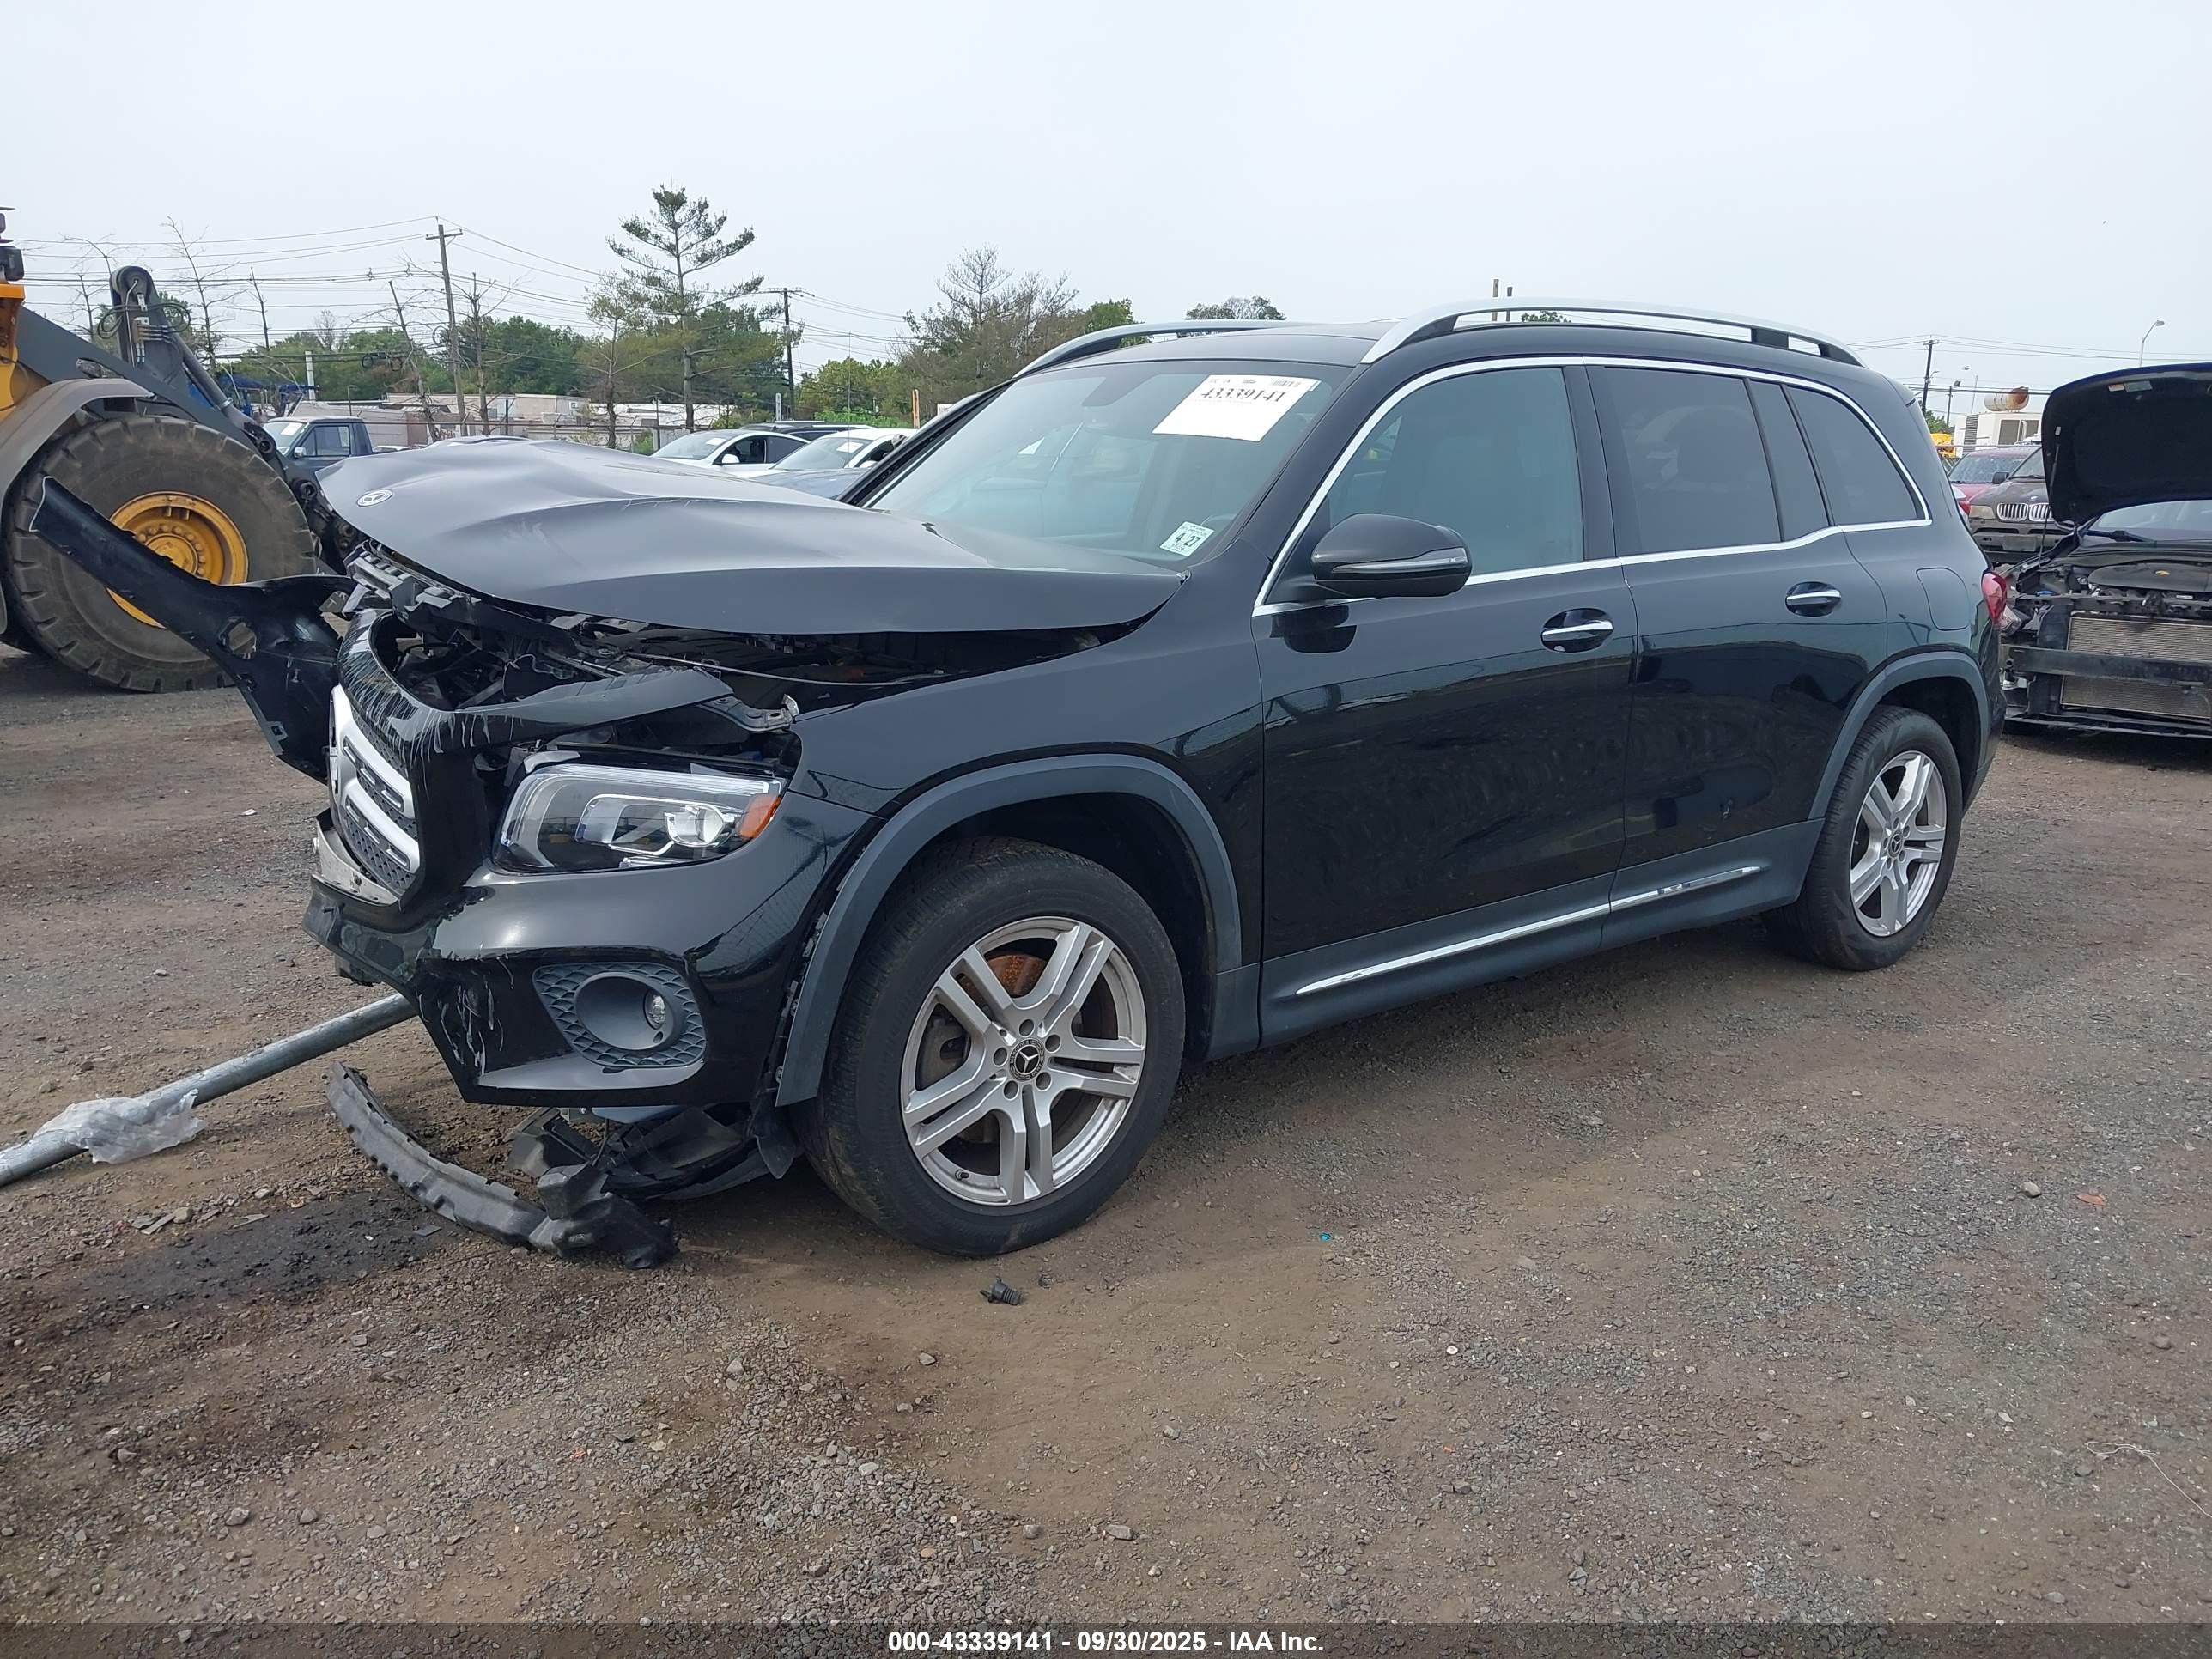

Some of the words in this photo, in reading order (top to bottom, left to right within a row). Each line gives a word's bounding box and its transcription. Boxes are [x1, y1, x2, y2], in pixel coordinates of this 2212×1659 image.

[1201, 387, 1287, 403] 43339141
[1175, 532, 1186, 544] 4
[1183, 535, 1202, 548] 27
